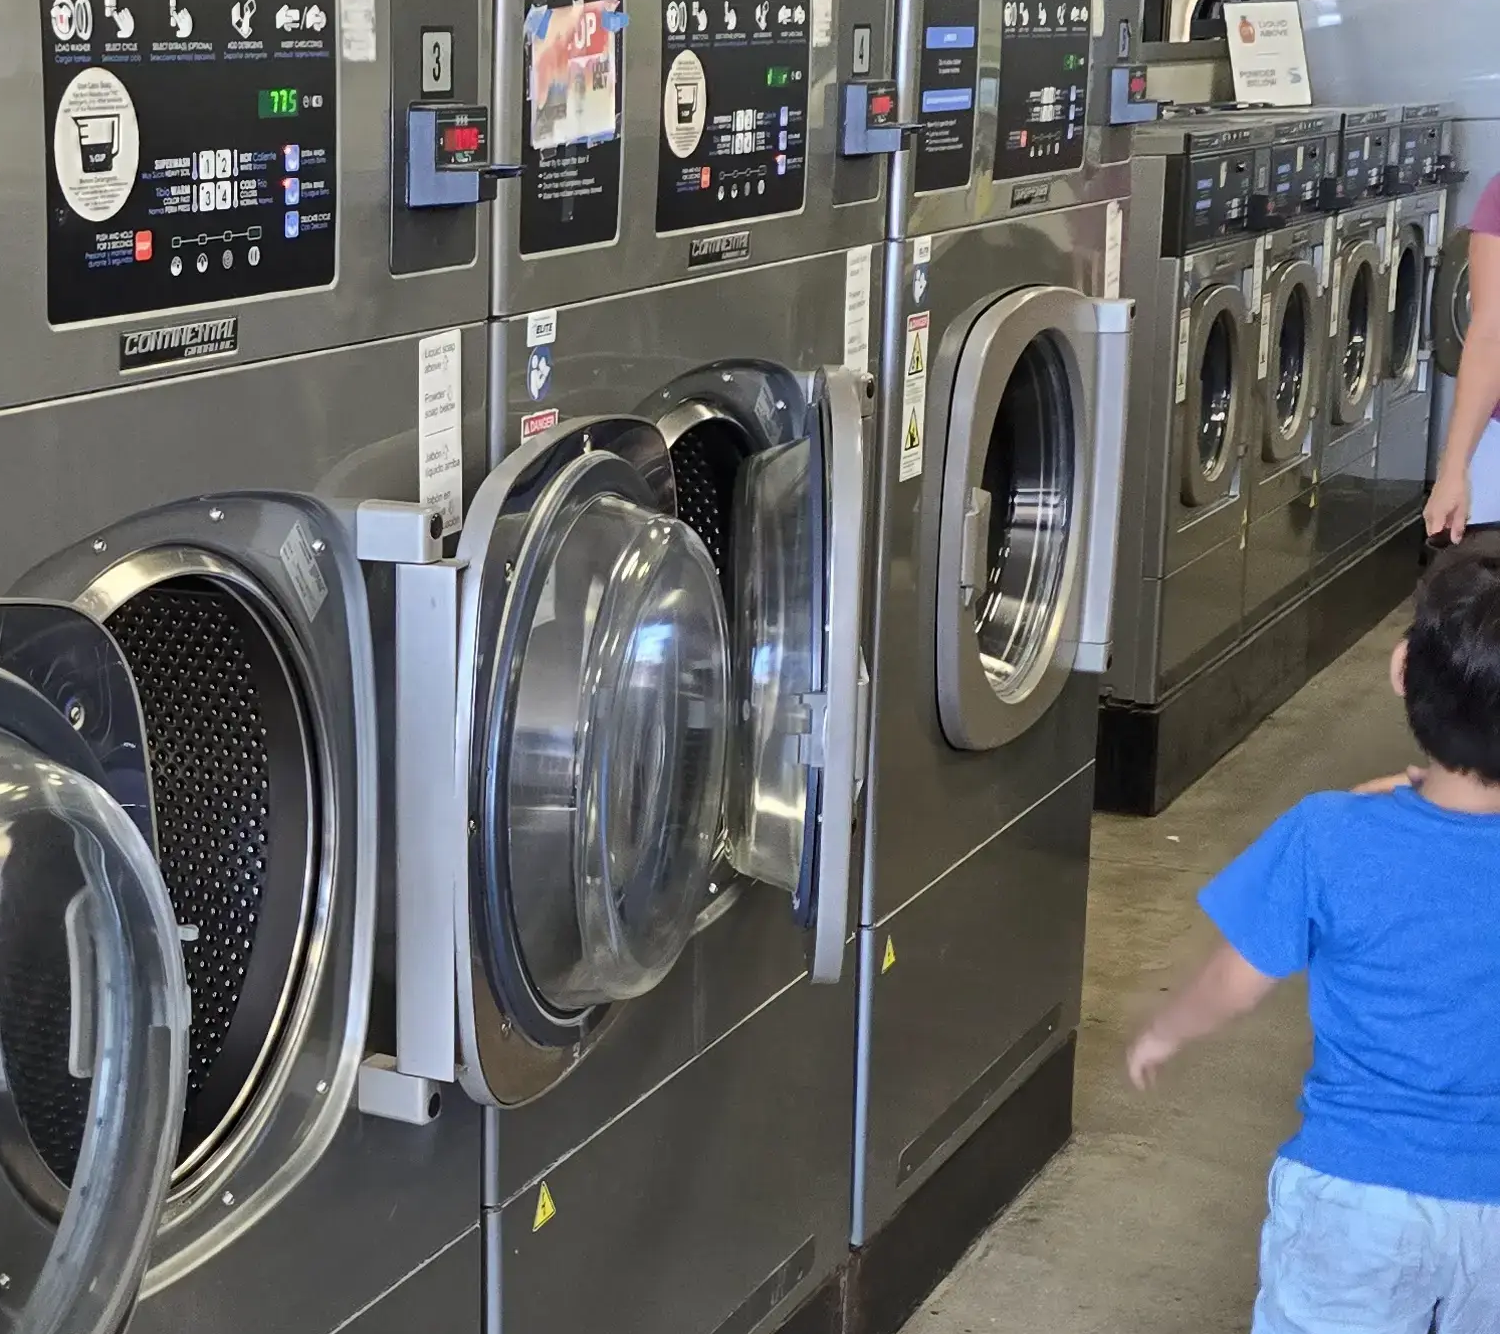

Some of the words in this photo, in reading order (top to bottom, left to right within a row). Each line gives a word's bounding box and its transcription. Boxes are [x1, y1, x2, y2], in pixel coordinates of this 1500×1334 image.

[432, 41, 441, 82] 3
[123, 318, 236, 356] CONTINENTAL
[530, 414, 556, 431] DANGER
